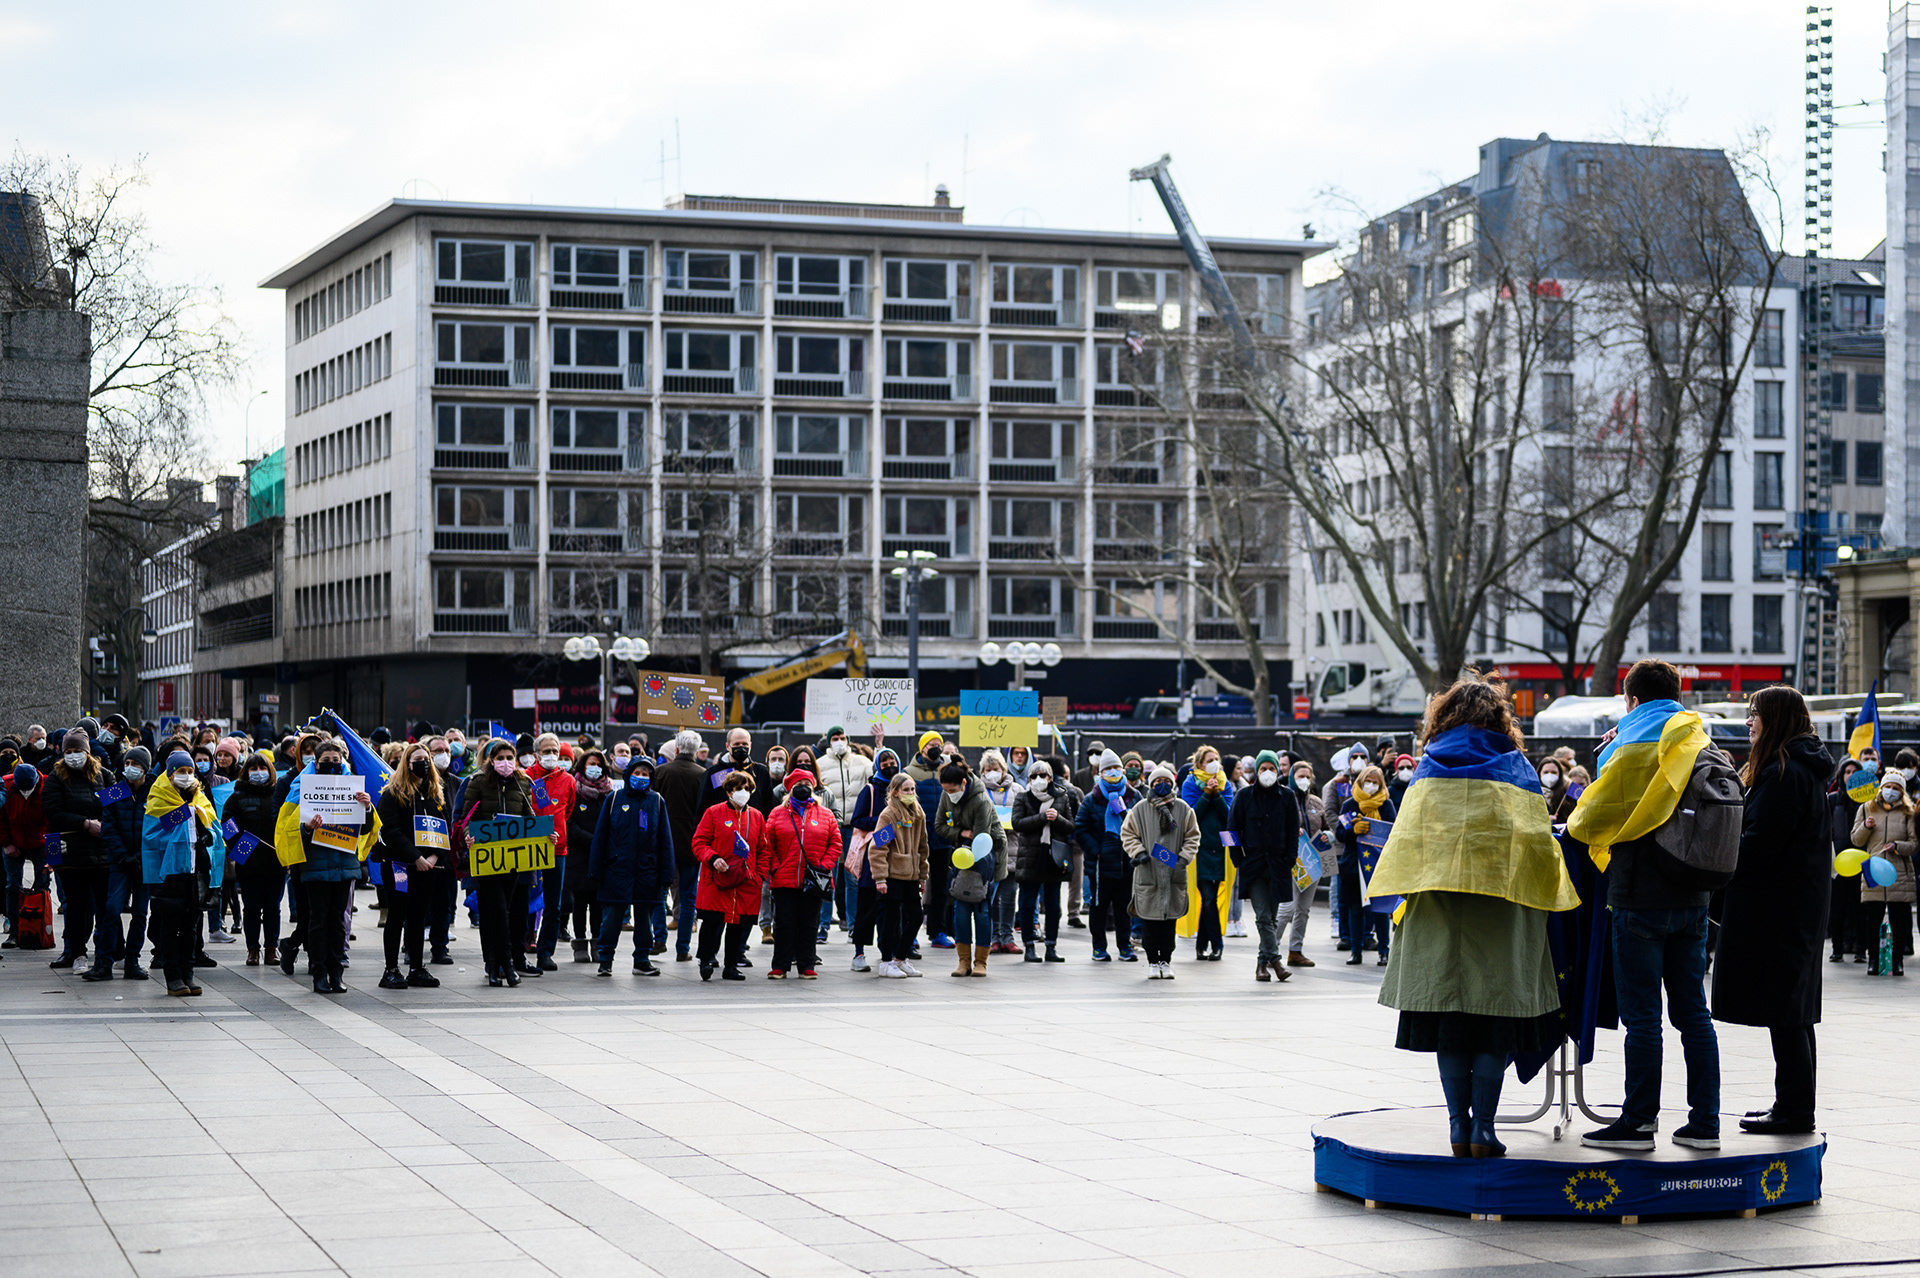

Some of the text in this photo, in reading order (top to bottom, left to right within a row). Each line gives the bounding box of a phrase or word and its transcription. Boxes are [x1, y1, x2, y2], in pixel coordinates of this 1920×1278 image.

[844, 678, 912, 693] STOP GENOCIDE
[857, 691, 898, 706] CLOSE
[974, 696, 1031, 715] CLOSE
[845, 710, 859, 723] the
[866, 705, 909, 724] SKY
[988, 715, 1005, 723] the
[534, 721, 581, 735] genau
[978, 721, 1007, 740] SKY
[303, 793, 329, 801] CLOSE
[331, 793, 346, 801] THE
[337, 824, 354, 833] PUTIN
[421, 818, 442, 829] STOP
[478, 817, 537, 844] STOP
[321, 830, 350, 842] STOP WAR
[421, 833, 444, 844] PUTIN
[475, 842, 549, 875] PUTIN
[1321, 855, 1330, 875] WAR
[1328, 855, 1336, 867] NO
[1660, 1181, 1691, 1191] PULSE
[1702, 1178, 1743, 1189] EUROPE
